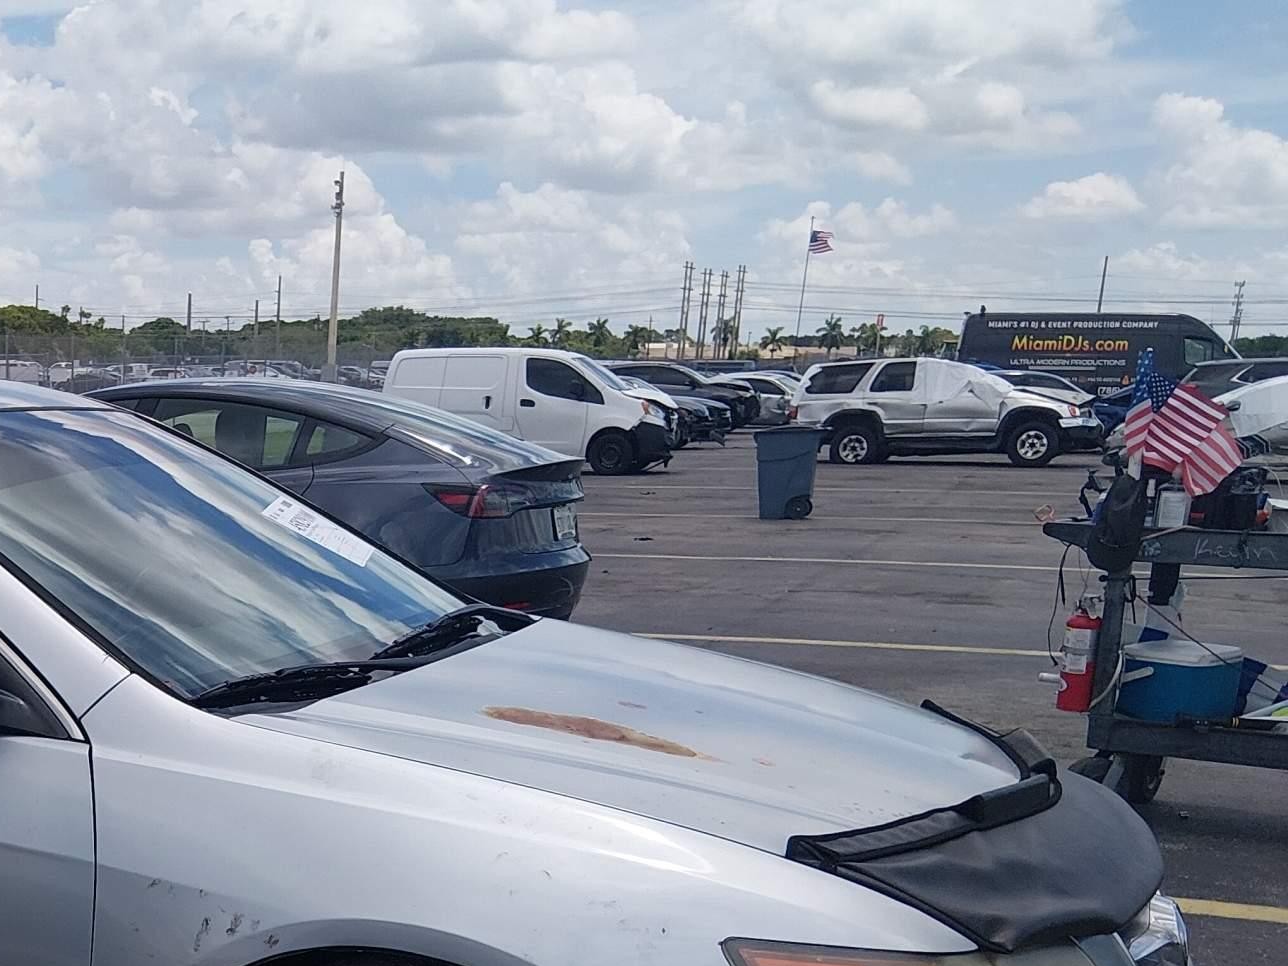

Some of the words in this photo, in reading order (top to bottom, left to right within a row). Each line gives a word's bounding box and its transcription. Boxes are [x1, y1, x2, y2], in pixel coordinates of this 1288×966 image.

[988, 320, 1018, 328] MIAMI'S
[1073, 321, 1120, 329] PRODUCTION
[1011, 335, 1129, 351] MiamiDJs.com
